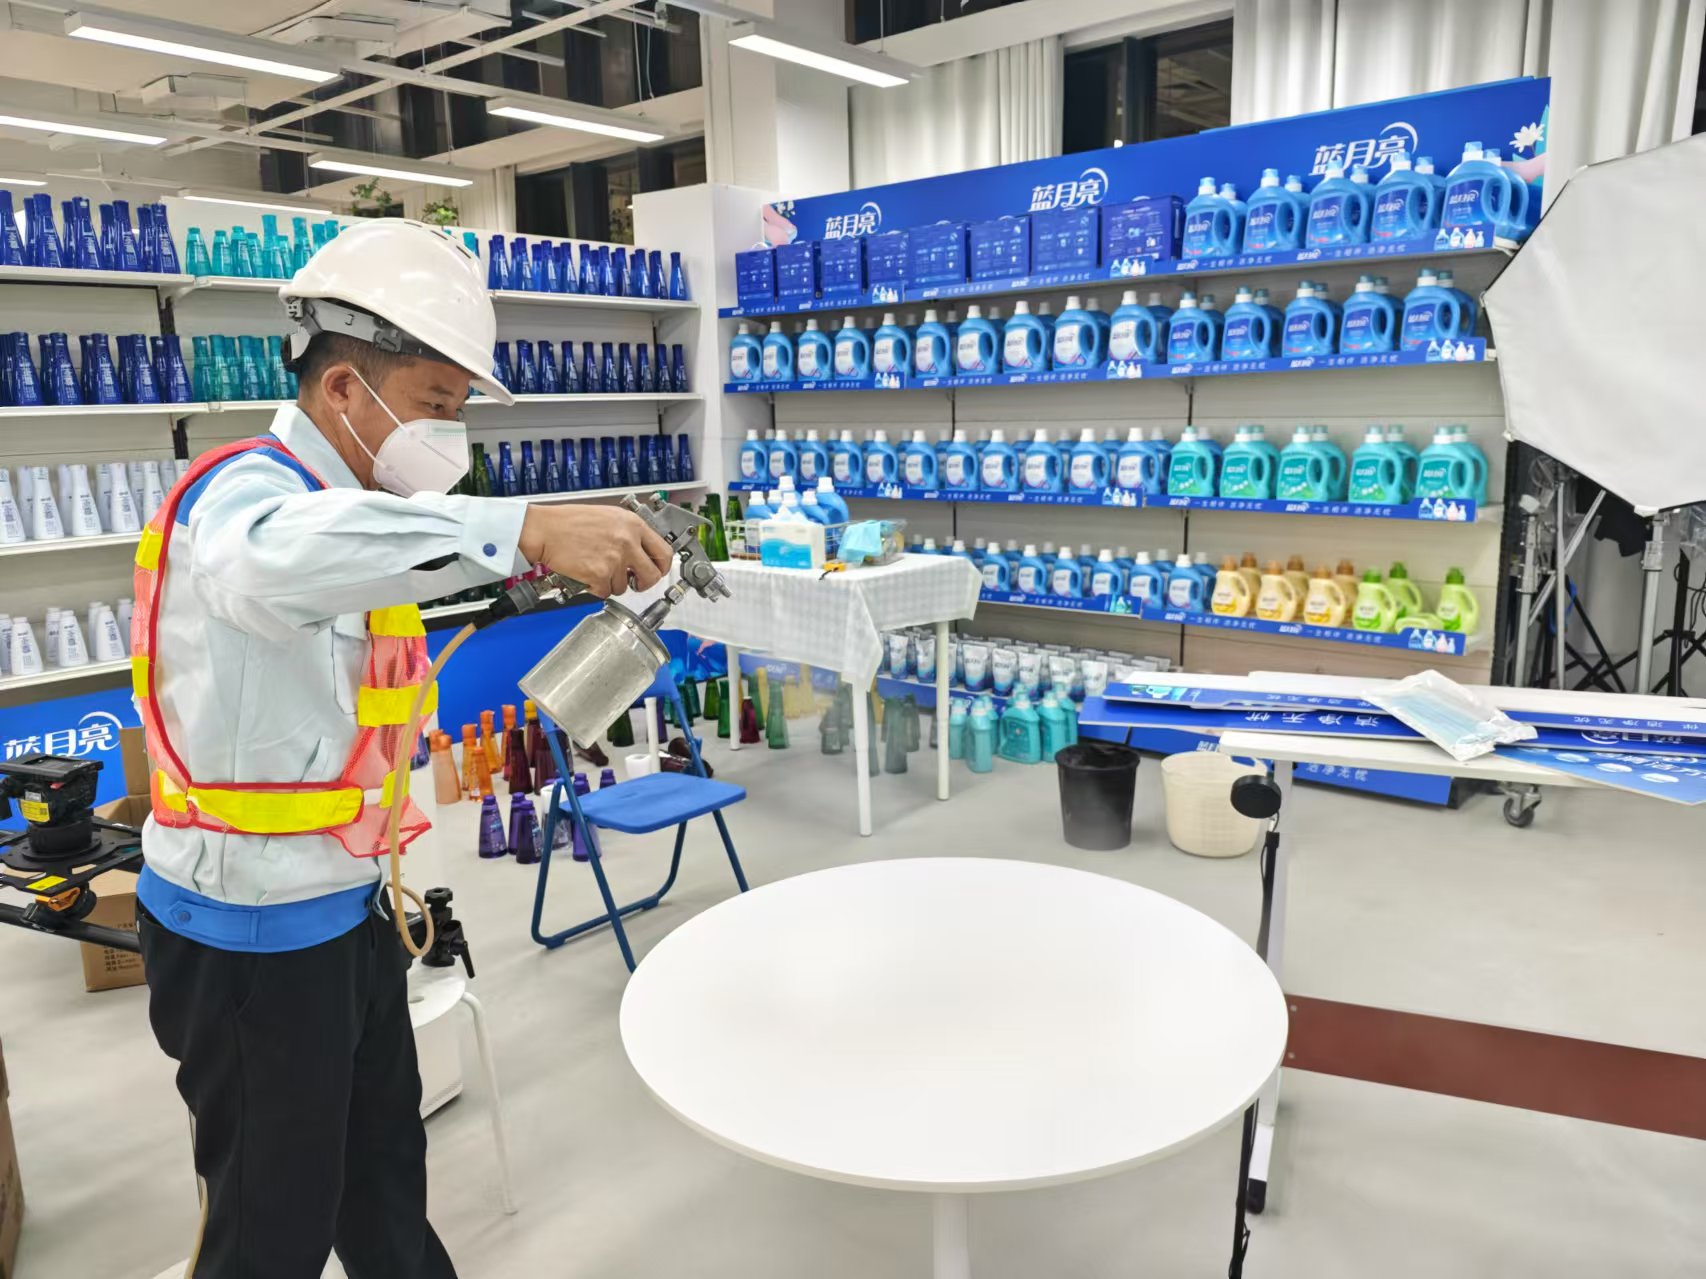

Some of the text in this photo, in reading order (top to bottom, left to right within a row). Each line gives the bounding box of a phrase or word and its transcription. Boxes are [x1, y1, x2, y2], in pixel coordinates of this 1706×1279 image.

[1308, 125, 1417, 177] 蓝月亮
[1028, 170, 1107, 212] 蓝月亮
[824, 204, 881, 240] 蓝月亮
[3, 715, 122, 758] 蓝月亮
[1244, 711, 1379, 727] 洁净无忧
